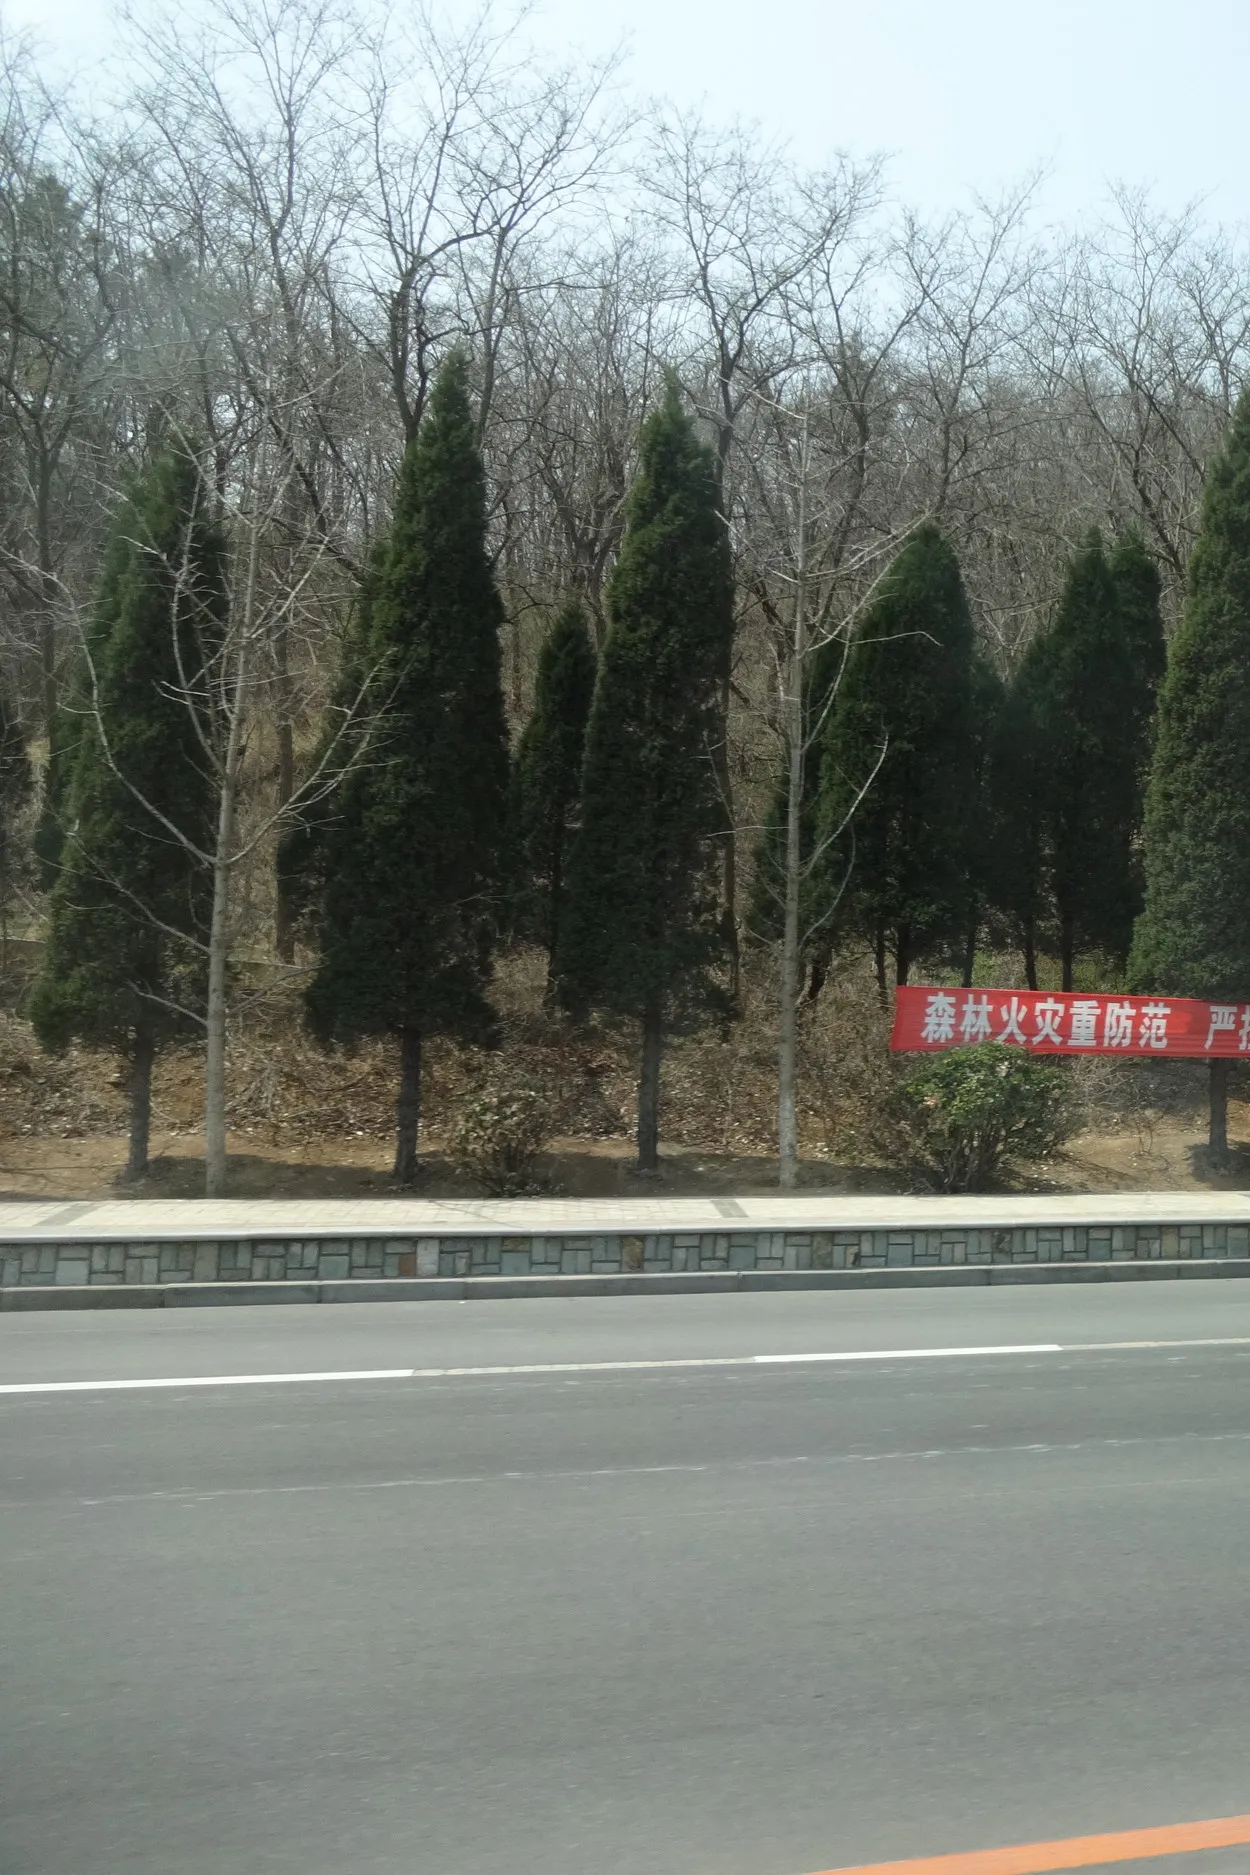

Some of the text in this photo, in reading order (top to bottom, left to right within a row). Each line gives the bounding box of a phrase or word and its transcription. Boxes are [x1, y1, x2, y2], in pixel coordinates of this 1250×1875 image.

[921, 992, 1171, 1048] 森林火灾重防范
